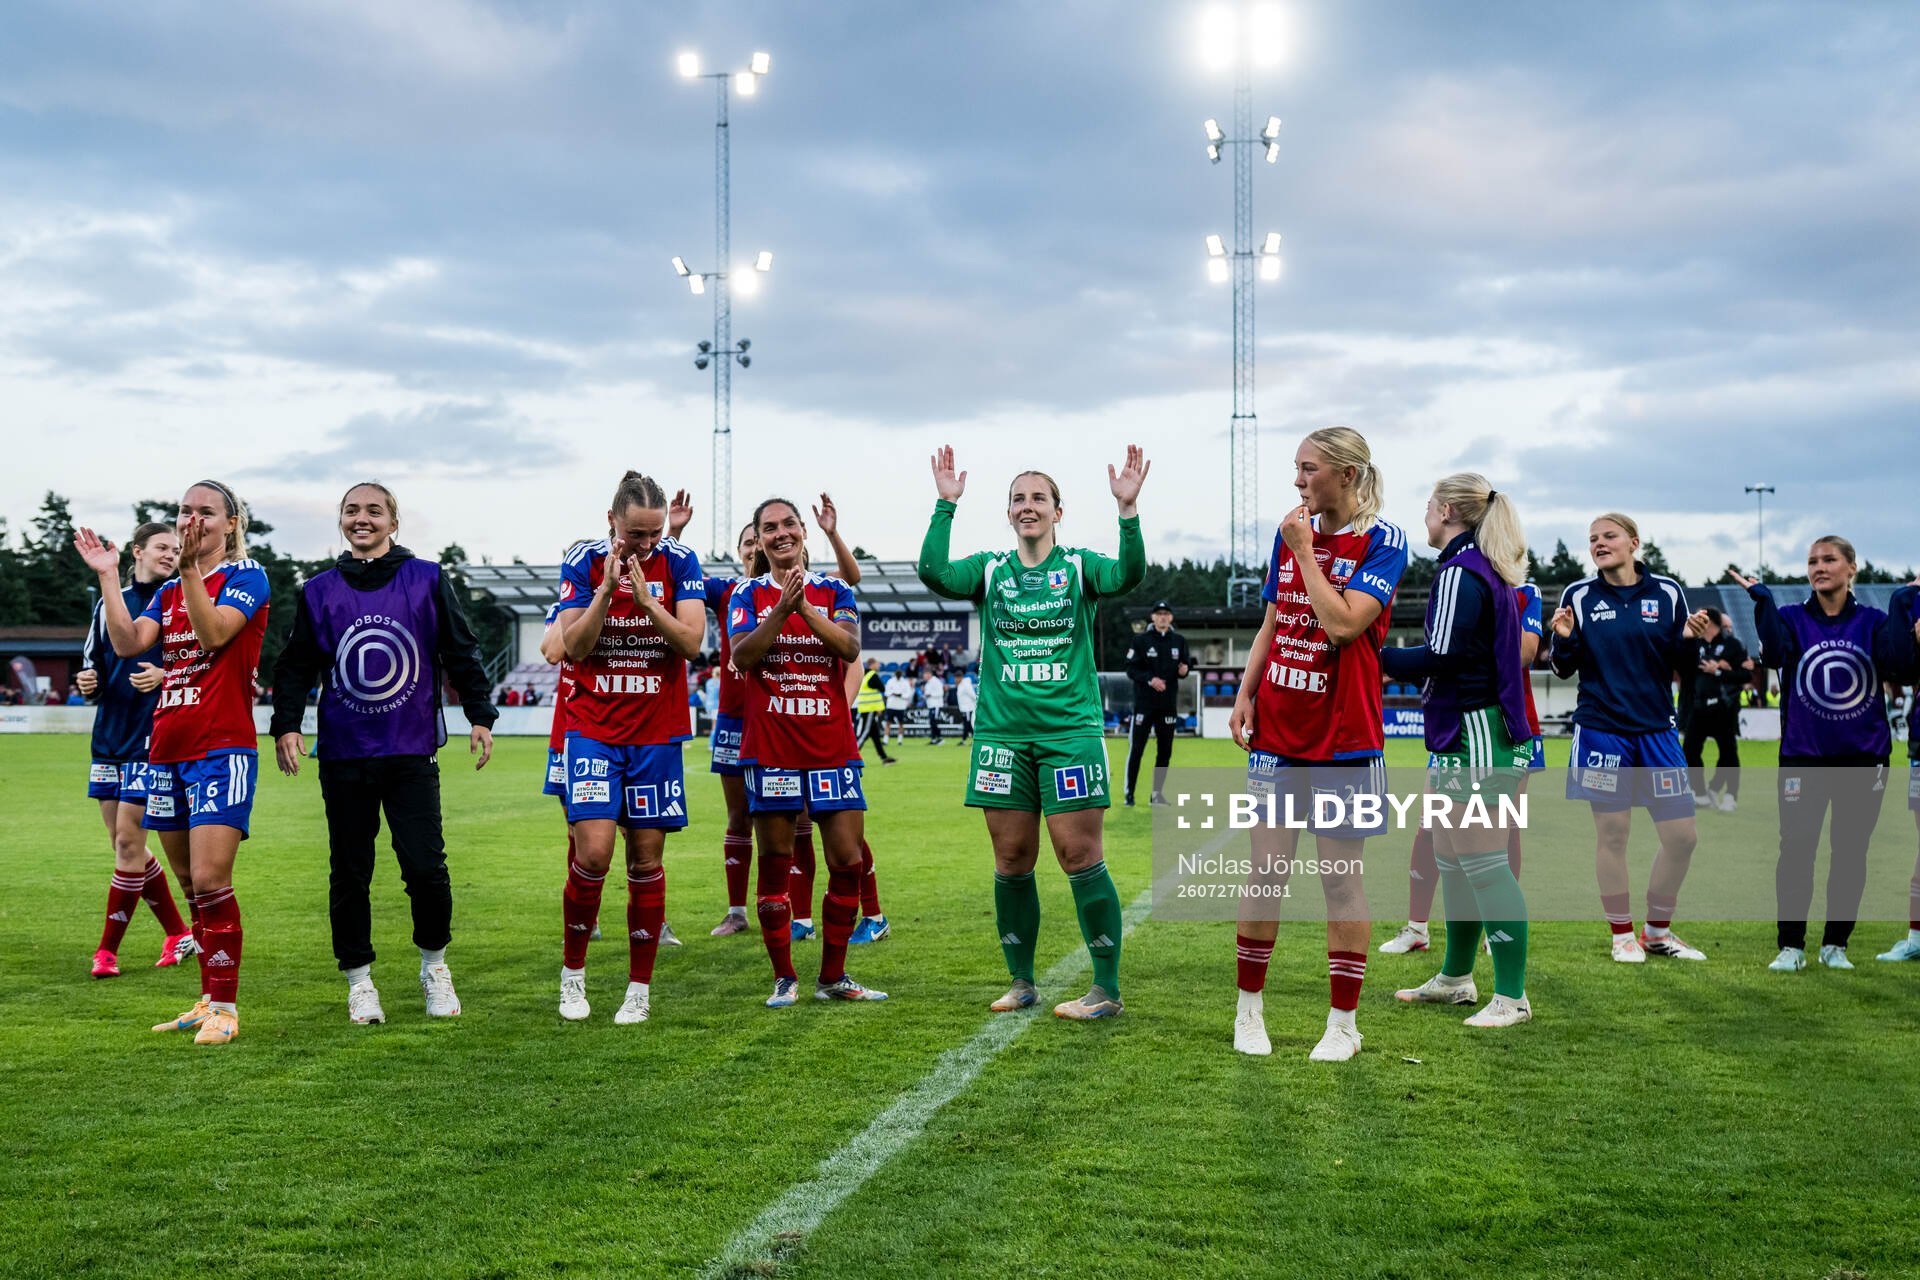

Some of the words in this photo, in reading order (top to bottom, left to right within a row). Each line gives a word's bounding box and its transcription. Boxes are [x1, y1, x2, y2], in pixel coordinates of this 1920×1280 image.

[355, 614, 391, 627] OBOS
[868, 616, 929, 632] GÖINGE
[933, 619, 962, 632] BIL
[993, 617, 1025, 631] Vittsjö
[1028, 617, 1075, 629] Omsorg
[994, 636, 1073, 648] Snapphanebygdens
[1820, 639, 1852, 649] OBOS
[793, 652, 832, 667] Omsorg
[1012, 648, 1053, 659] Sparbank
[607, 658, 648, 669] Sparbank
[1001, 662, 1068, 682] NIBE
[593, 674, 662, 694] NIBE
[780, 682, 817, 693] Sparbank
[766, 695, 831, 716] NIBE
[131, 761, 148, 775] 12
[1089, 763, 1104, 781] 13
[1876, 764, 1884, 778] 7
[843, 768, 854, 784] 9
[206, 781, 218, 797] 6
[664, 780, 681, 798] 16
